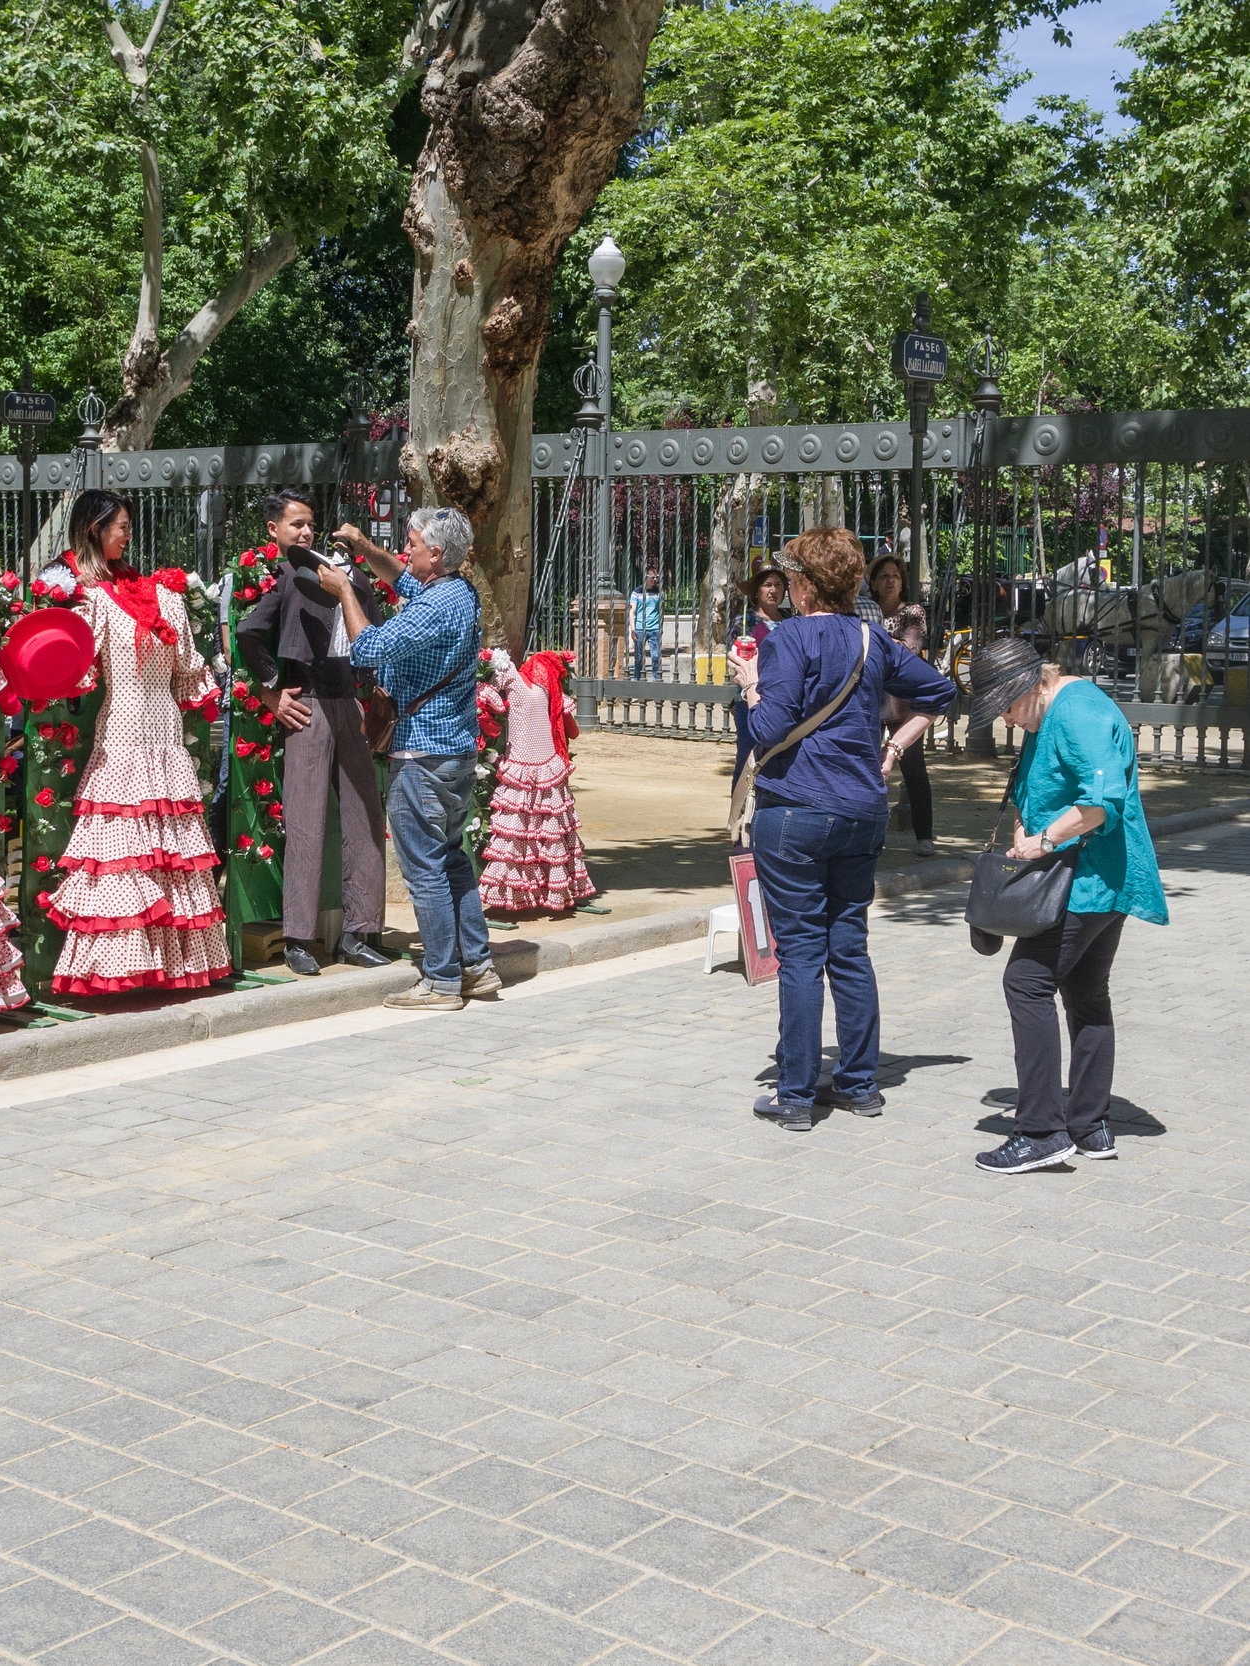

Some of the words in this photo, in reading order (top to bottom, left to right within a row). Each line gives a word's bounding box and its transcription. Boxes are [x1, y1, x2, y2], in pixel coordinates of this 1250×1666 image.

[915, 340, 940, 353] PASEO
[908, 357, 921, 371] ISABEL
[15, 396, 46, 405] PASEO
[8, 409, 23, 419] ISABEL
